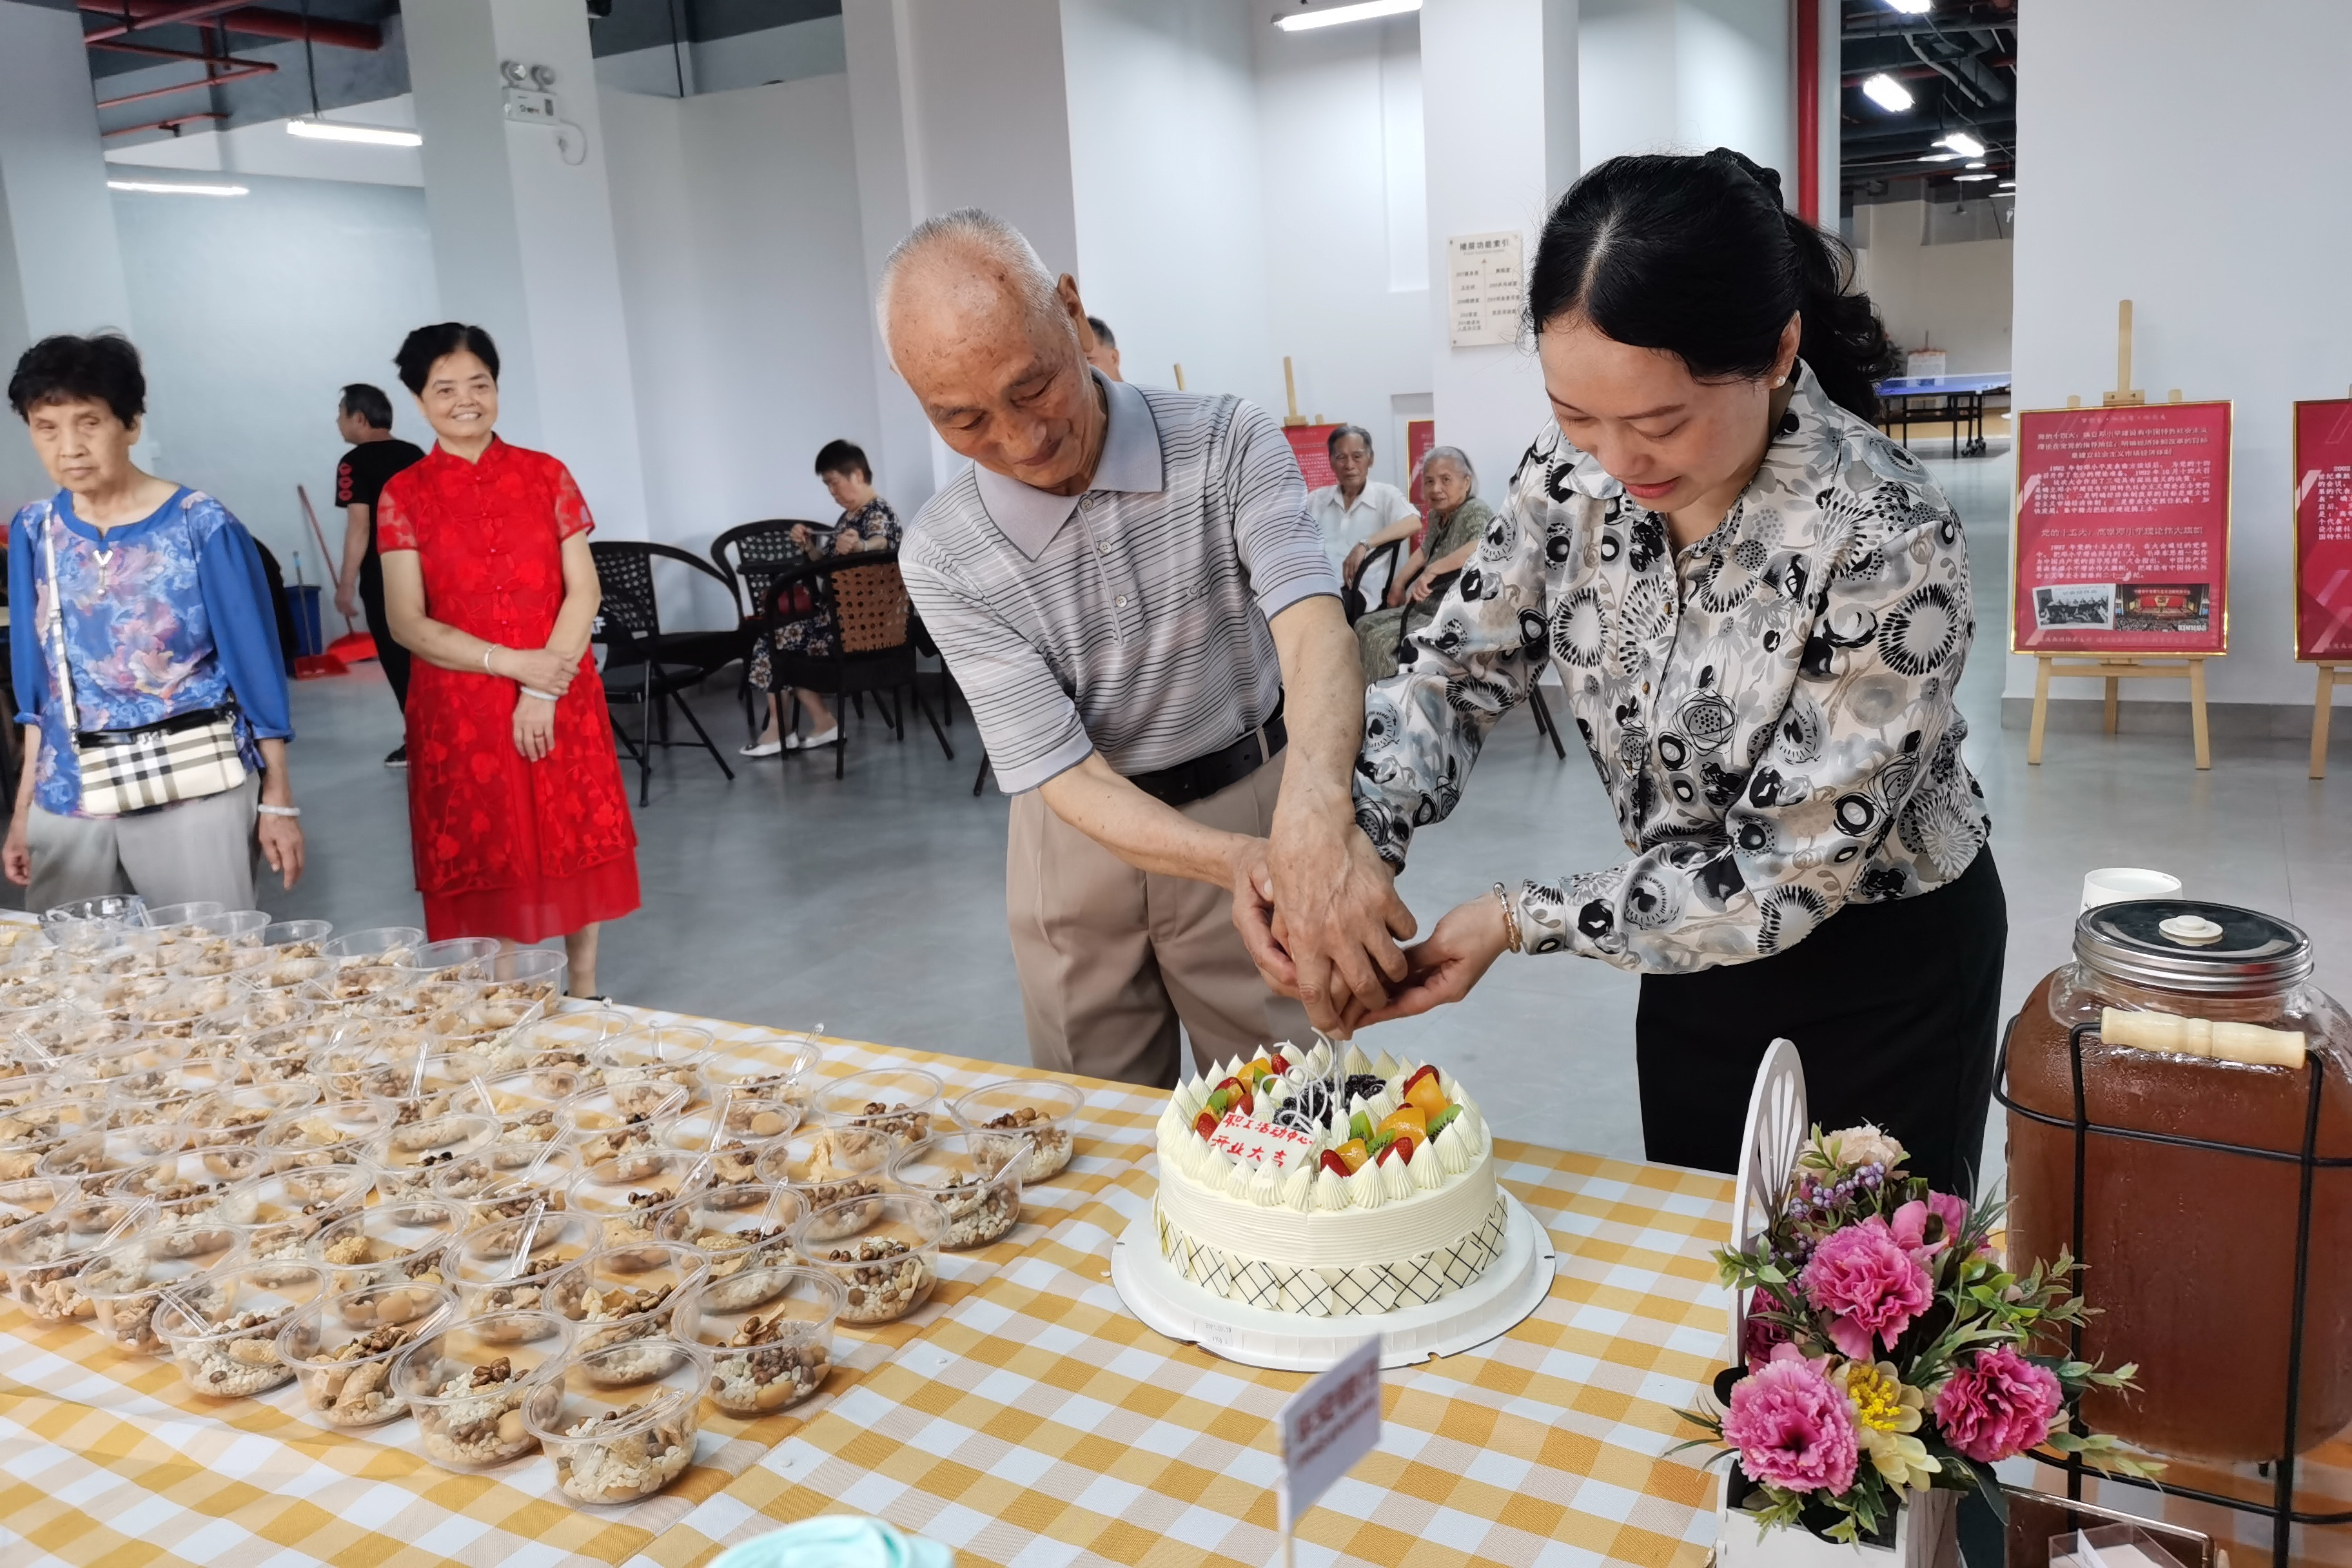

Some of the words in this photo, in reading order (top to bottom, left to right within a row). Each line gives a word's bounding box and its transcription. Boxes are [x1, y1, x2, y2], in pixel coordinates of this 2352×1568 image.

[1222, 1114, 1314, 1145] 职工活动中心
[1210, 1135, 1288, 1168] 开业大吉
